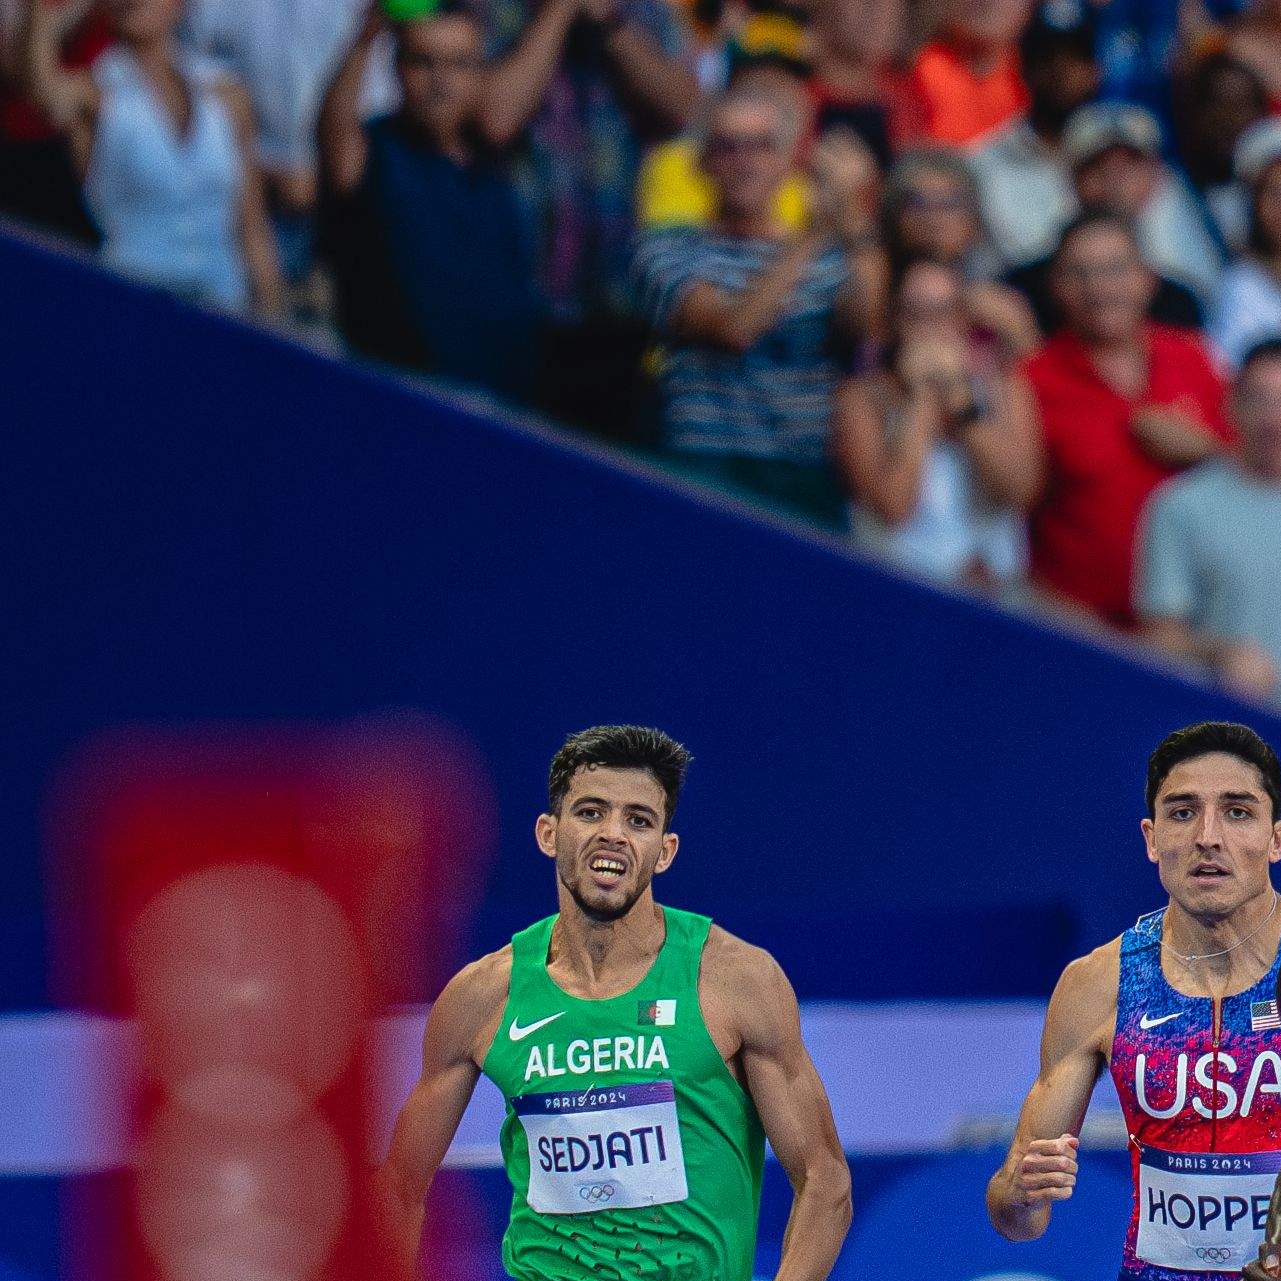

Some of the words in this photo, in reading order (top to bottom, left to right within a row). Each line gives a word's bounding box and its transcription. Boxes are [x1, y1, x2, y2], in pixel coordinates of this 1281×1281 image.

[524, 1035, 670, 1082] ALGERIA
[545, 1097, 586, 1109] PARIS
[590, 1092, 627, 1106] 2024
[537, 1125, 667, 1173] SEDJATI
[1168, 1156, 1207, 1169] PARIS
[1212, 1158, 1251, 1170] 2024
[1147, 1186, 1272, 1232] HOPPE
